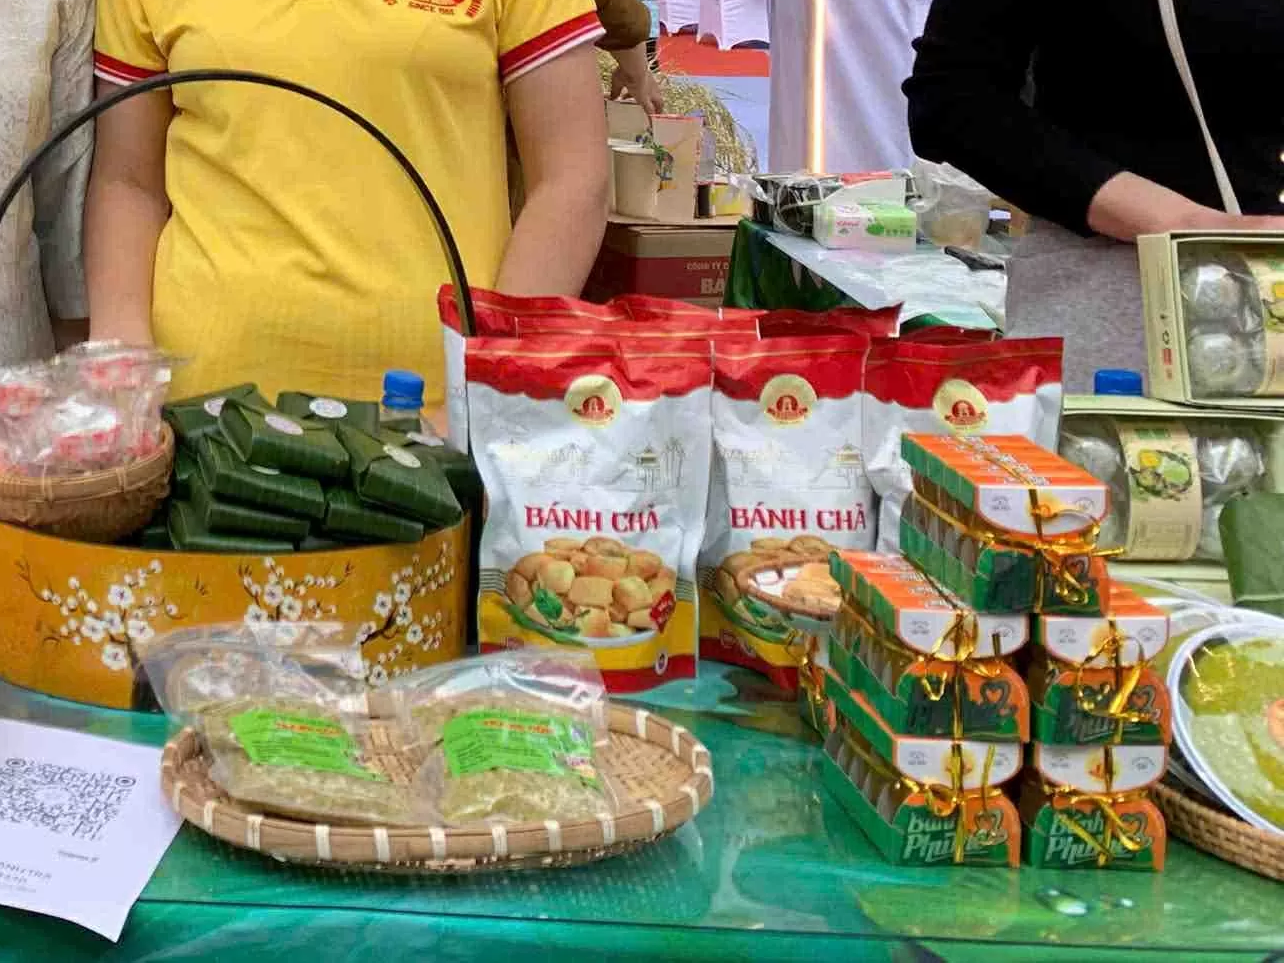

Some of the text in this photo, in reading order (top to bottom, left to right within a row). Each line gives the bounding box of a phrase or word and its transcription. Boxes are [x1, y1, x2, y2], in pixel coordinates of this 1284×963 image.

[524, 501, 660, 534] BÁNH CHẢ
[730, 501, 866, 531] BÁNH CHẢ
